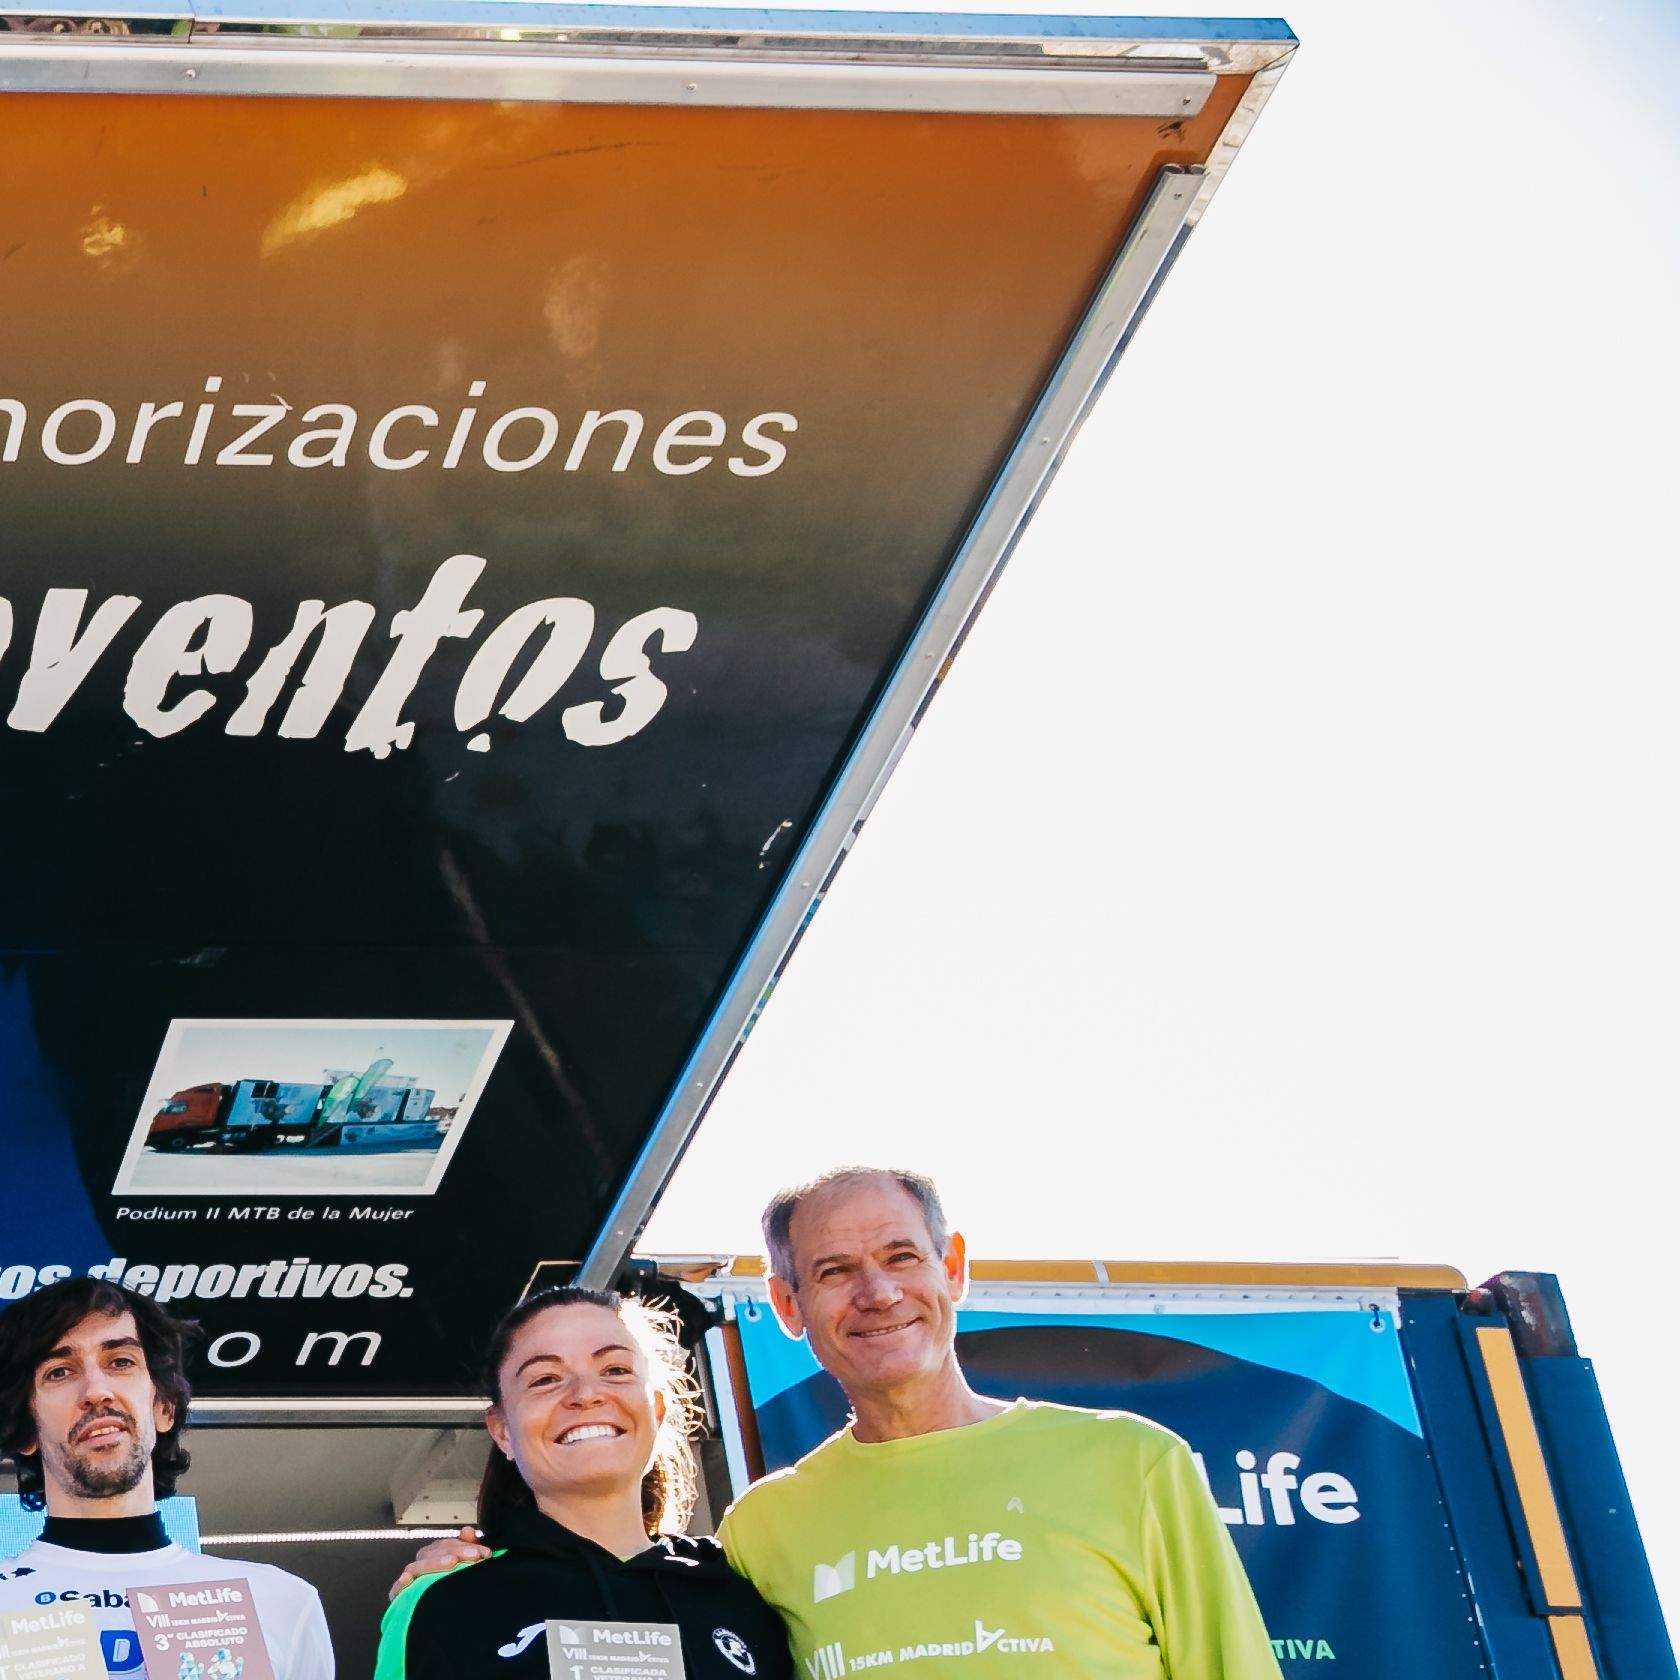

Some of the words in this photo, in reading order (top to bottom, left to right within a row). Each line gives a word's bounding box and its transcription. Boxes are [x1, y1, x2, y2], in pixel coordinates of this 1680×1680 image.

[115, 1206, 197, 1221] Podium
[206, 1207, 221, 1220] II
[228, 1206, 281, 1220] MTB
[287, 1206, 315, 1220] de
[322, 1206, 341, 1220] la
[348, 1206, 415, 1222] Mujer
[1192, 1449, 1362, 1526] Life
[866, 1532, 1024, 1579] MetLife
[168, 1587, 244, 1608] MetLife
[10, 1610, 86, 1635] MetLife
[176, 1626, 249, 1642] CLASIFICADO
[185, 1635, 245, 1650] ABSOLUTO
[592, 1628, 673, 1647] MetLife
[562, 1647, 588, 1661] VIII
[1270, 1638, 1337, 1661] TIVA
[848, 1649, 894, 1673] 15KM
[590, 1666, 668, 1677] CLASIFICADA
